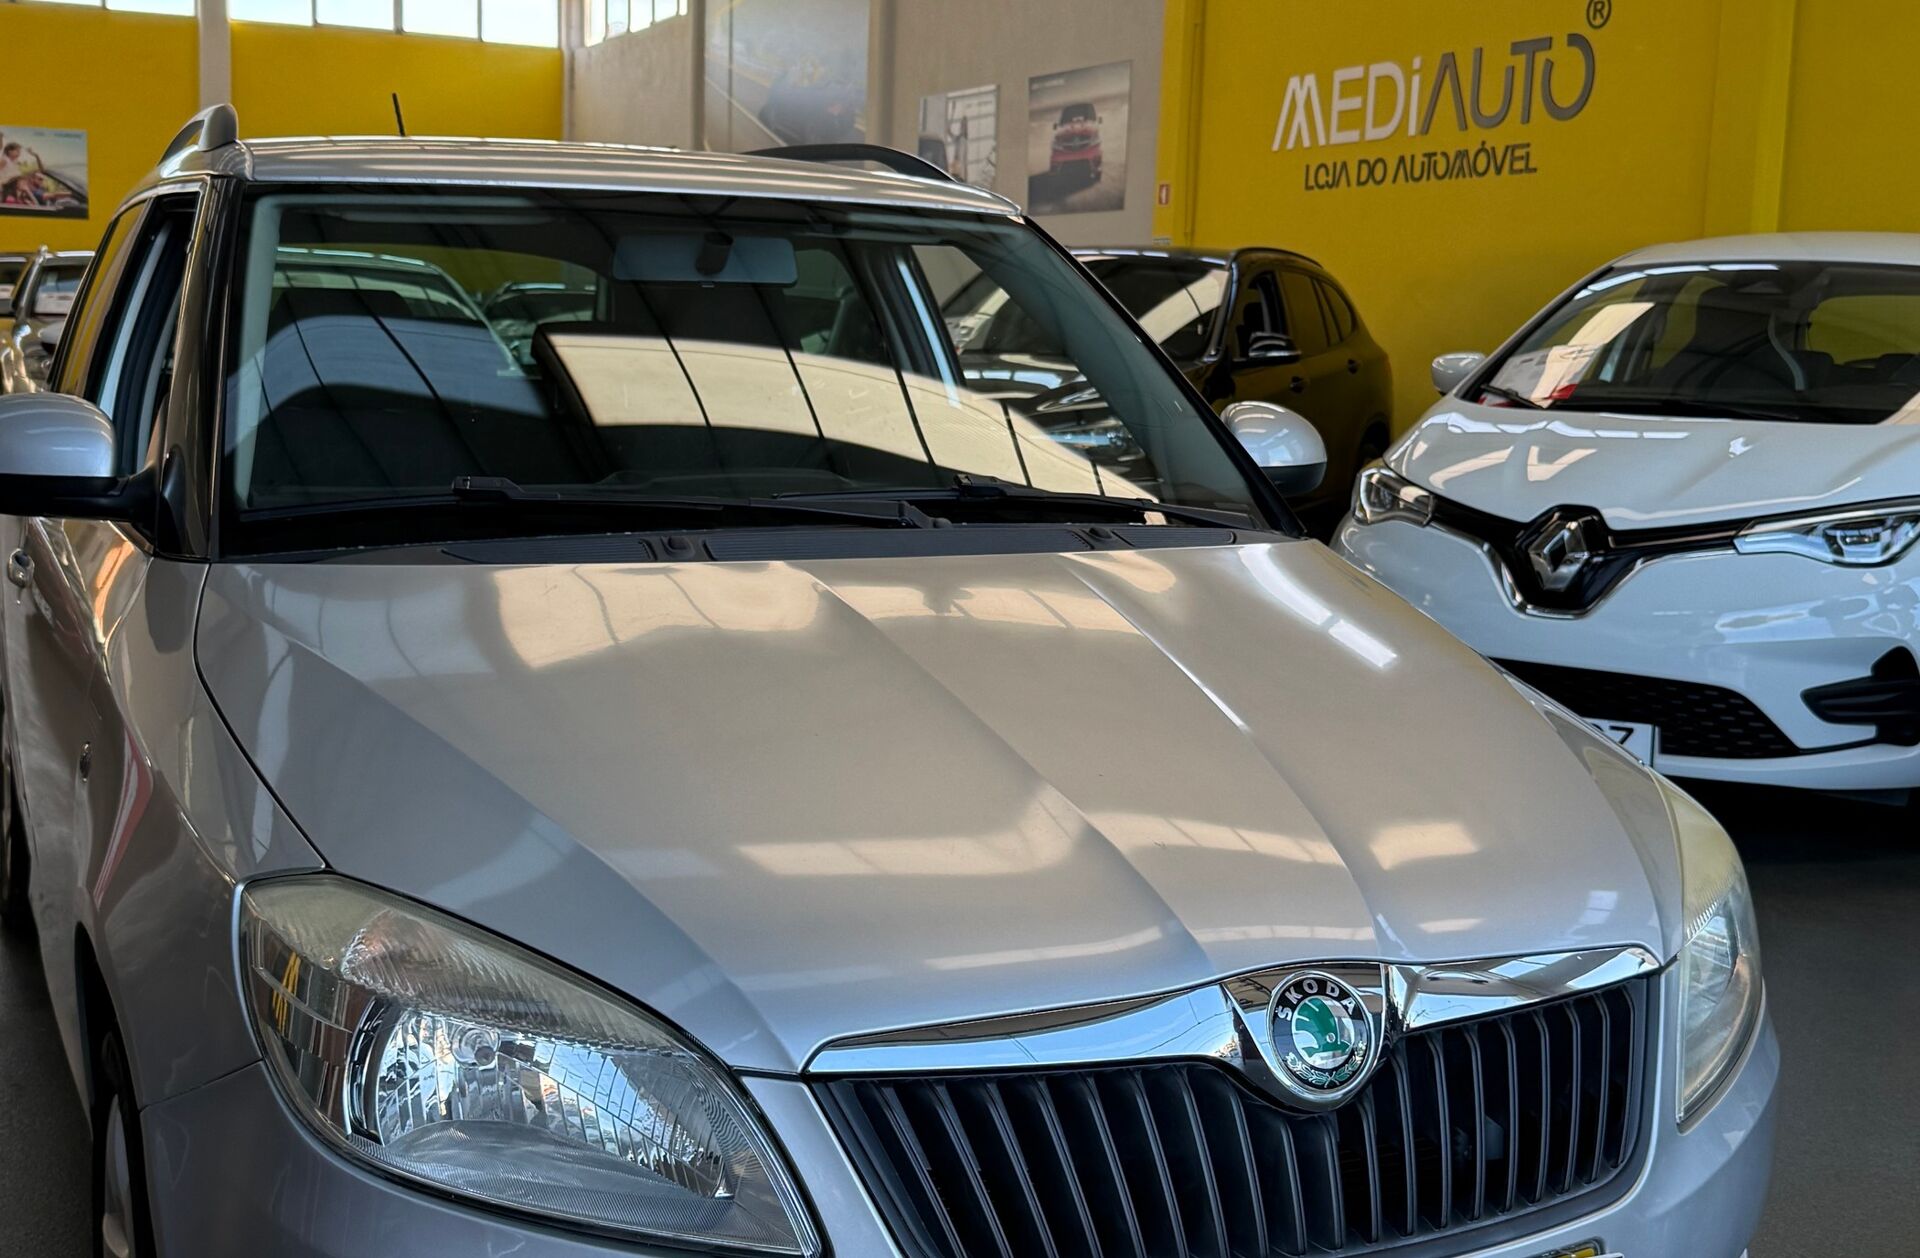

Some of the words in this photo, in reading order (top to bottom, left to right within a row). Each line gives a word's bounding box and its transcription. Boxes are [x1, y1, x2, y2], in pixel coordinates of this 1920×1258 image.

[1304, 163, 1351, 191] LOJA
[1356, 158, 1387, 186] DO
[1392, 141, 1537, 184] AUTOMÓVEL
